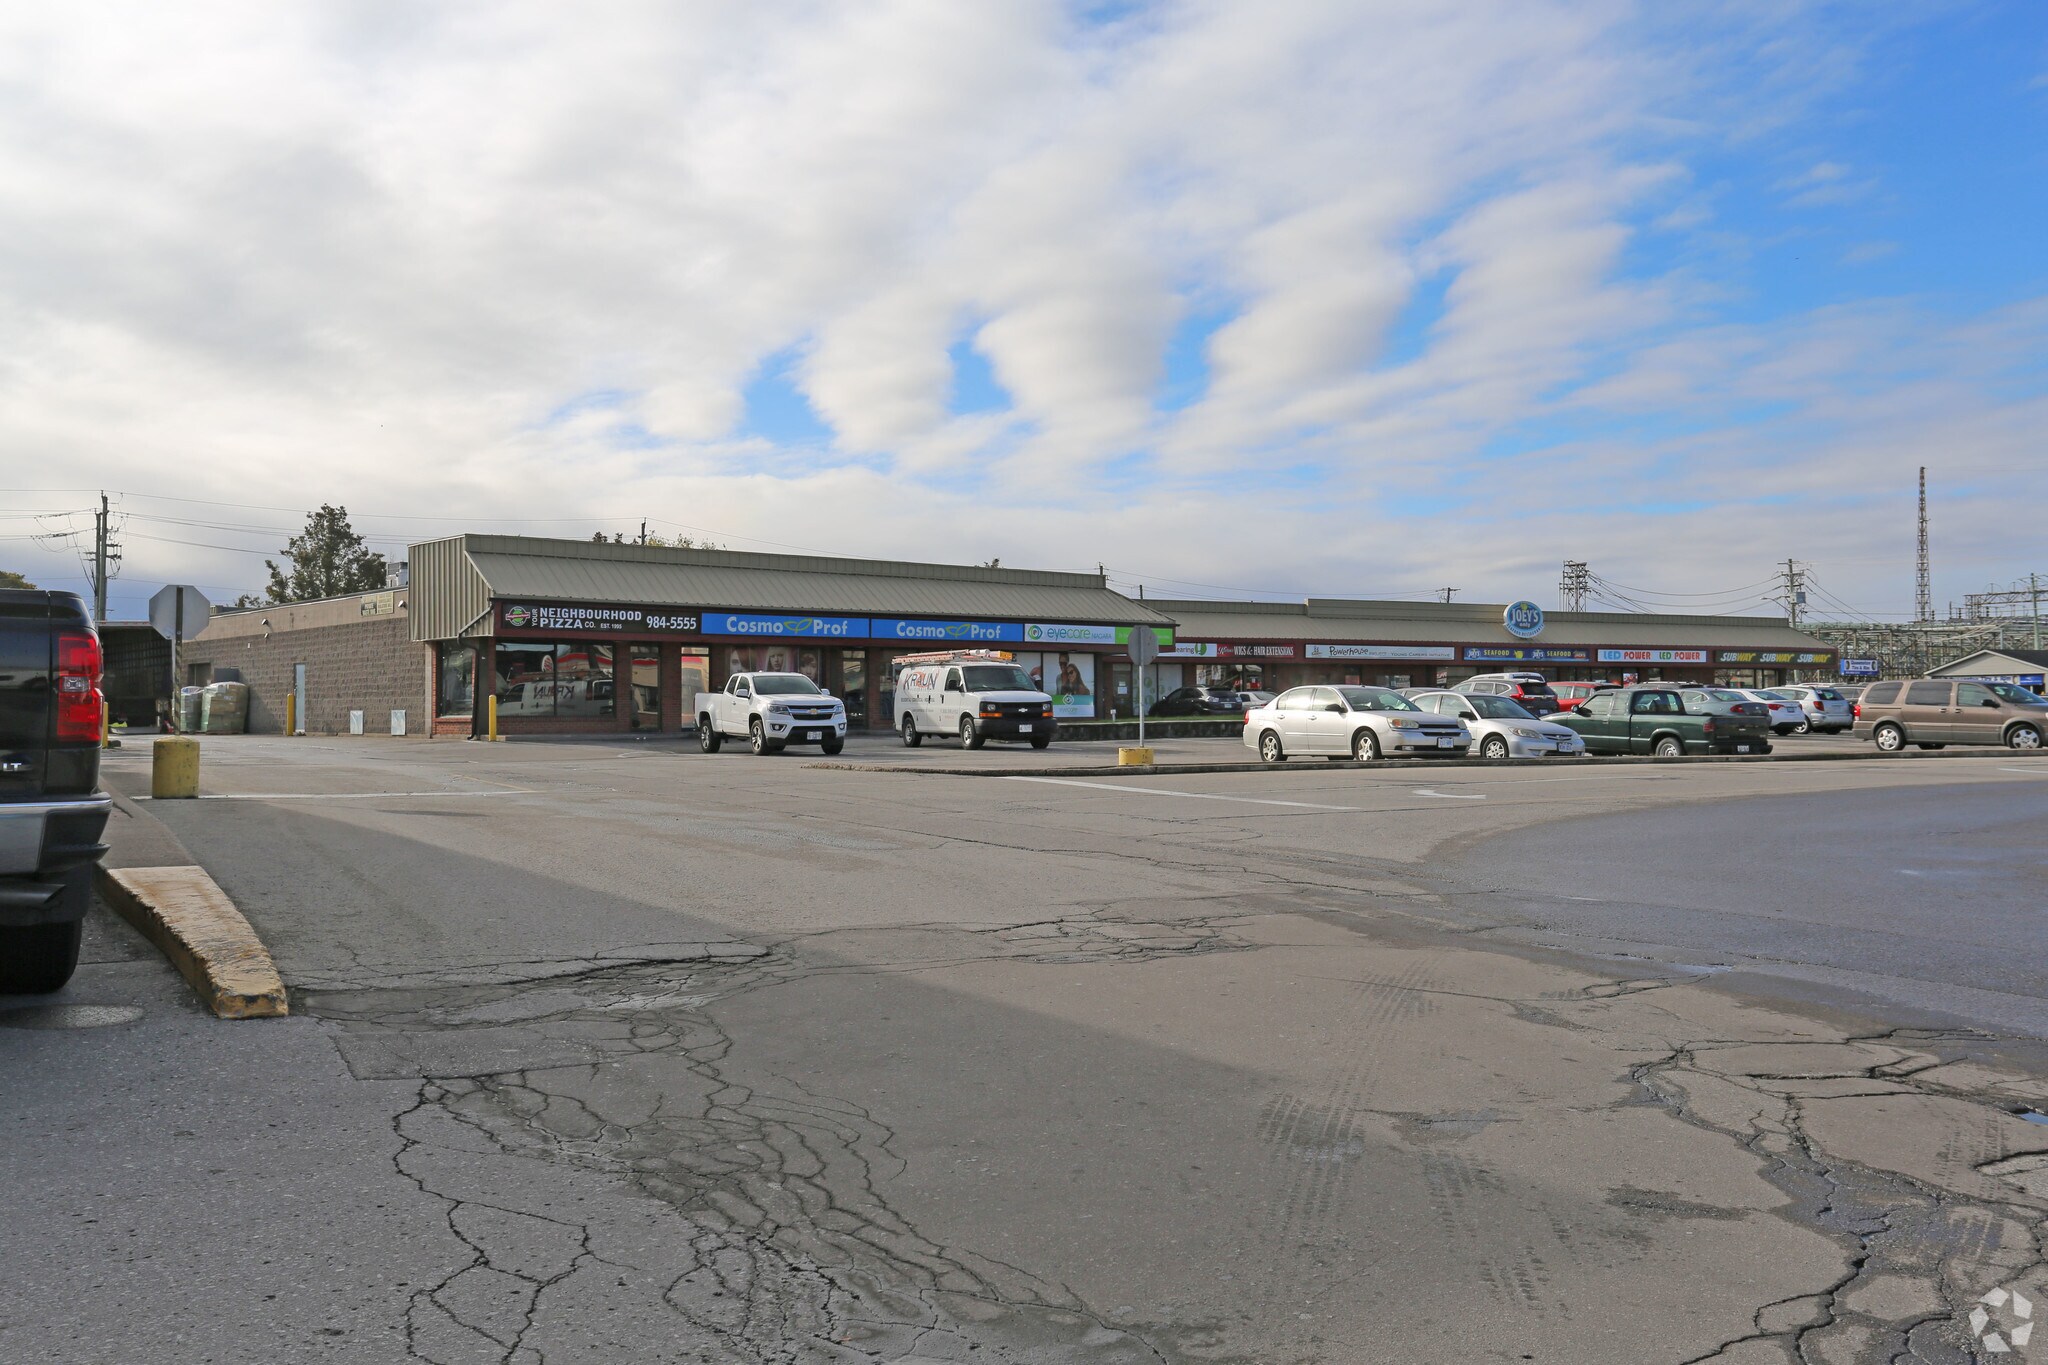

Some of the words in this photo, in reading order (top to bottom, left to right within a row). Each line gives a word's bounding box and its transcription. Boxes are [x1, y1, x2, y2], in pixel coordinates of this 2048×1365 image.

[539, 607, 642, 621] NEIGHBOURHOOD
[1512, 608, 1539, 625] JOEY'S
[539, 618, 583, 629] PIZZA
[584, 621, 596, 629] CO.
[646, 615, 697, 630] 984-5555
[726, 616, 784, 634] Cosmo
[813, 619, 848, 635] Prof
[896, 621, 946, 638] Cosmo
[971, 624, 1001, 639] Prof
[1047, 627, 1091, 641] eyecare
[1176, 646, 1195, 655] earing
[1234, 646, 1247, 656] WIGS
[1247, 646, 1253, 655] &
[1253, 646, 1266, 656] HAIR
[1266, 646, 1294, 656] EXTENSIONS
[1329, 646, 1369, 656] Powerhouse
[1603, 651, 1622, 660] LED
[1624, 651, 1651, 660] POWER
[1659, 651, 1672, 660] LED
[1674, 651, 1700, 660] POWER
[1720, 652, 1756, 662] SUBWAY
[1760, 653, 1795, 663] SUBWAY
[1797, 653, 1832, 663] SUBWAY
[3, 762, 22, 771] LT
